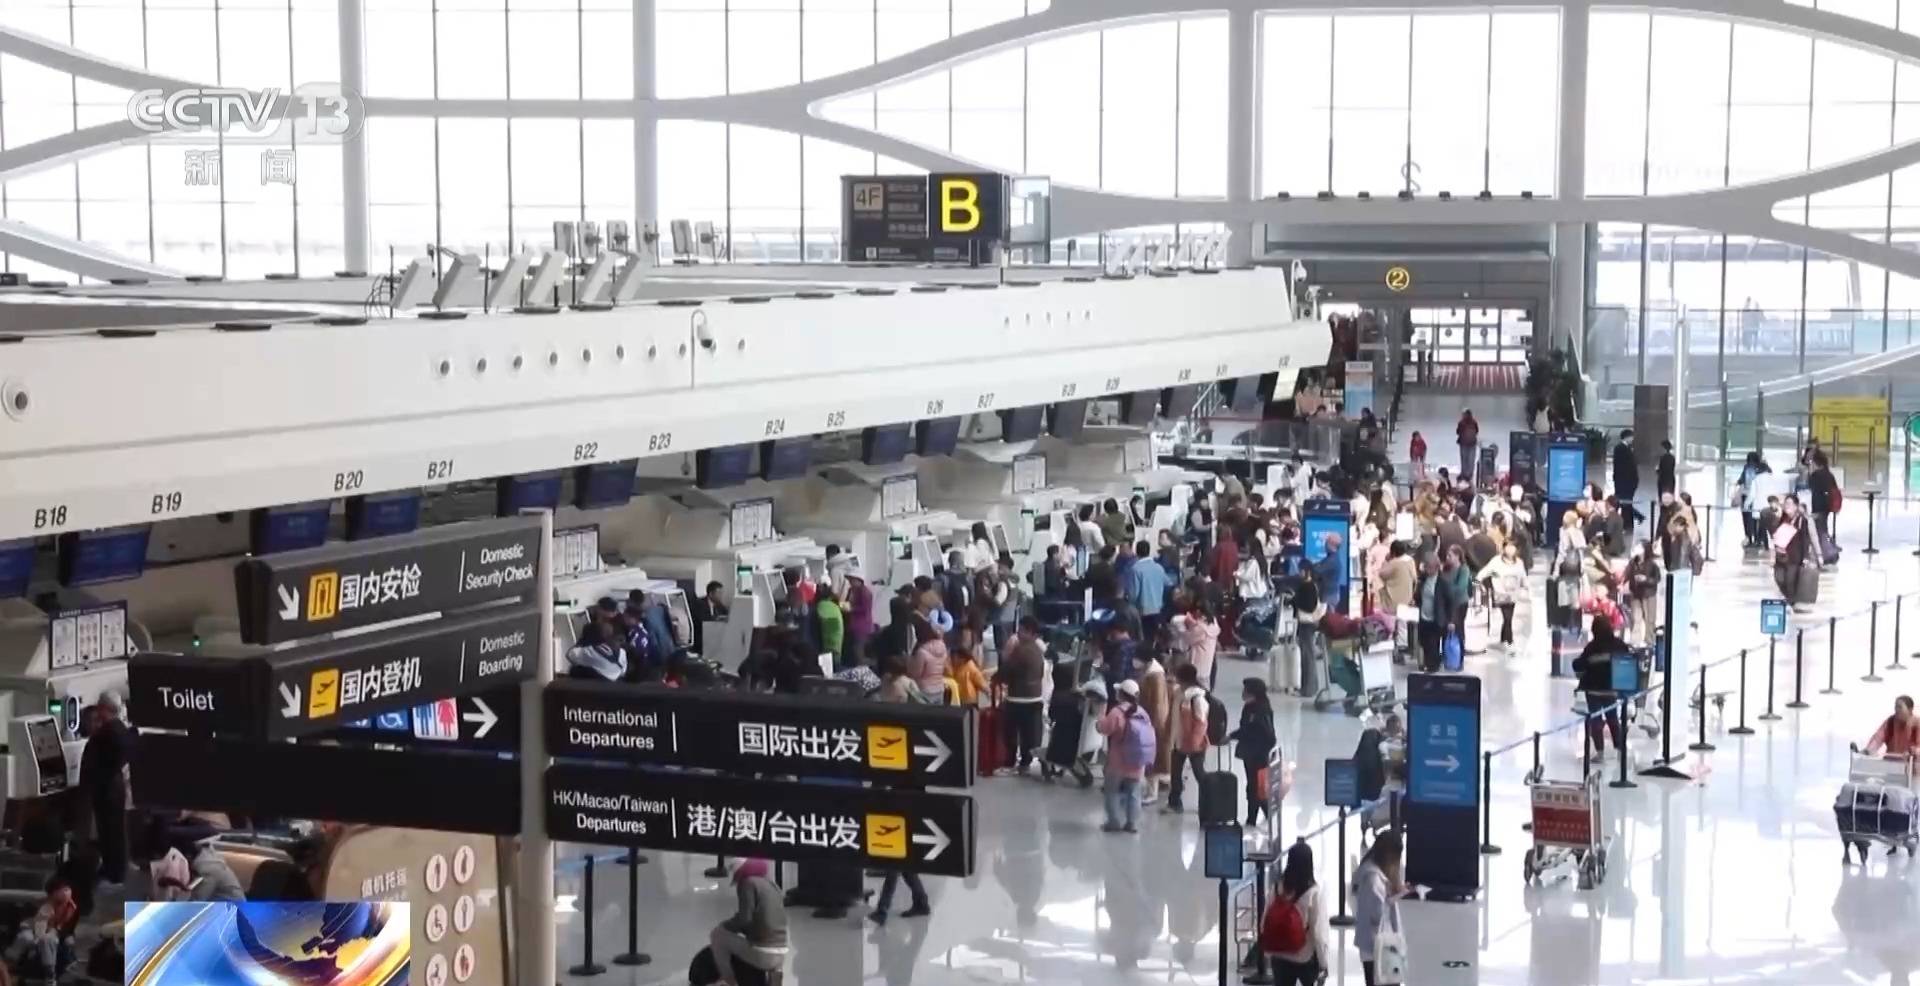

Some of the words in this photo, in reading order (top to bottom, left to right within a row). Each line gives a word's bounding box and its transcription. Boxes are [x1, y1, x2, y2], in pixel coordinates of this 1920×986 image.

[856, 186, 881, 206] 4F
[941, 179, 980, 233] B
[927, 400, 944, 414] B26
[976, 393, 995, 409] B27
[765, 420, 785, 435] B24
[827, 412, 845, 427] B25
[573, 442, 599, 462] B22
[648, 432, 673, 451] B23
[427, 459, 455, 480] B21
[333, 470, 365, 493] B20
[151, 491, 183, 514] B19
[34, 505, 68, 529] B18
[480, 543, 525, 565] Domestic
[338, 563, 422, 611] 国内安检
[465, 570, 504, 591] Security
[504, 562, 535, 583] Check
[479, 631, 526, 655] Domestic
[478, 653, 524, 678] Boarding
[339, 656, 422, 707] 国内登机
[157, 686, 216, 711] Toilet
[563, 705, 659, 729] International
[569, 727, 656, 750] Departures
[738, 721, 862, 763] 国际出发
[552, 789, 669, 815] HK/Macao/Taiwan
[576, 813, 648, 836] Departures
[687, 802, 861, 850] 港/澳/台出发
